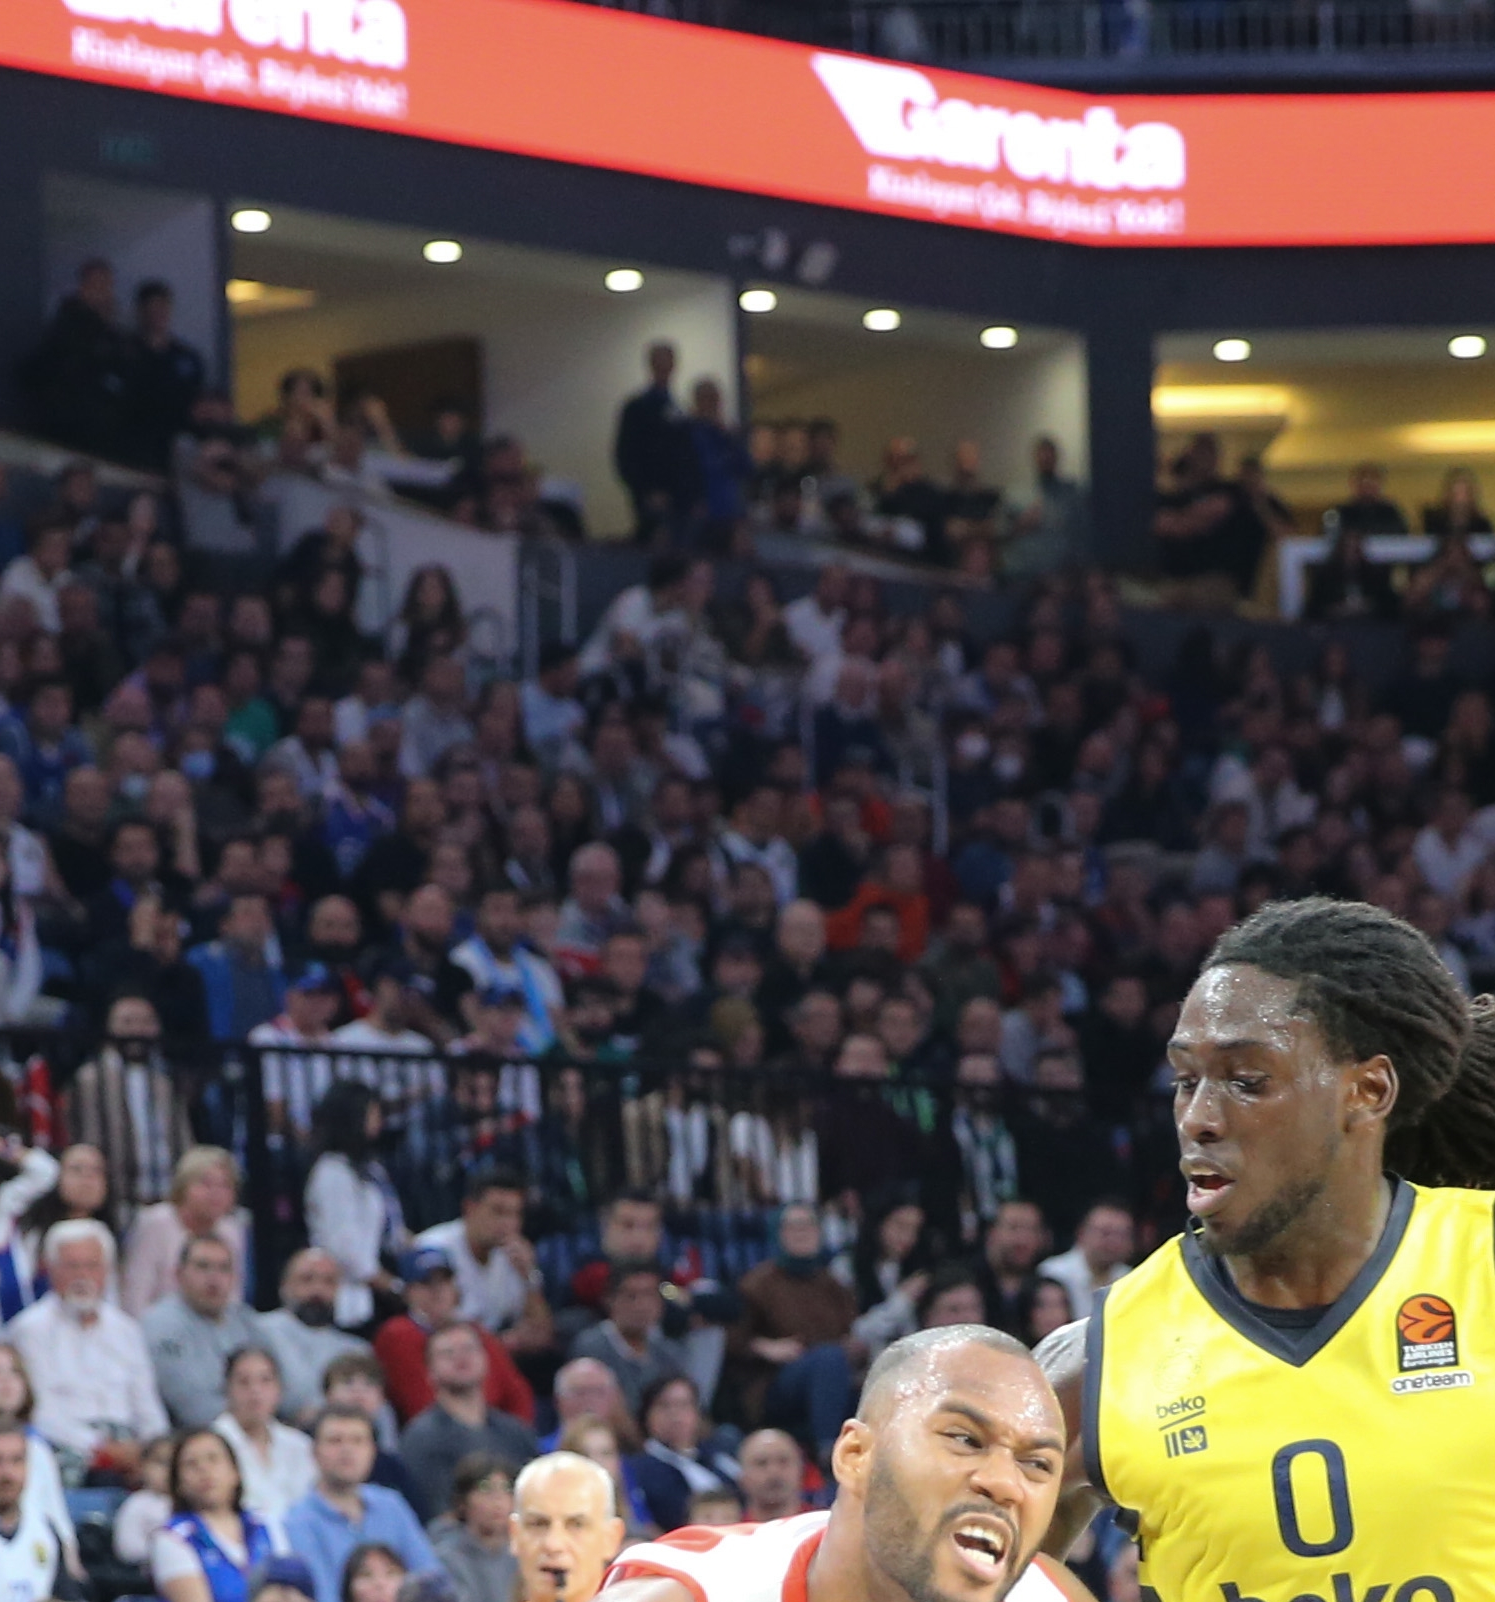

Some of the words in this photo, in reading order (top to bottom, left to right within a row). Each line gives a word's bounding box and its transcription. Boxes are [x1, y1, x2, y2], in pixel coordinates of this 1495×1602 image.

[63, 0, 409, 71] renta
[810, 52, 1187, 191] Garenta
[1156, 1395, 1206, 1419] beko
[1271, 1438, 1355, 1558] 0
